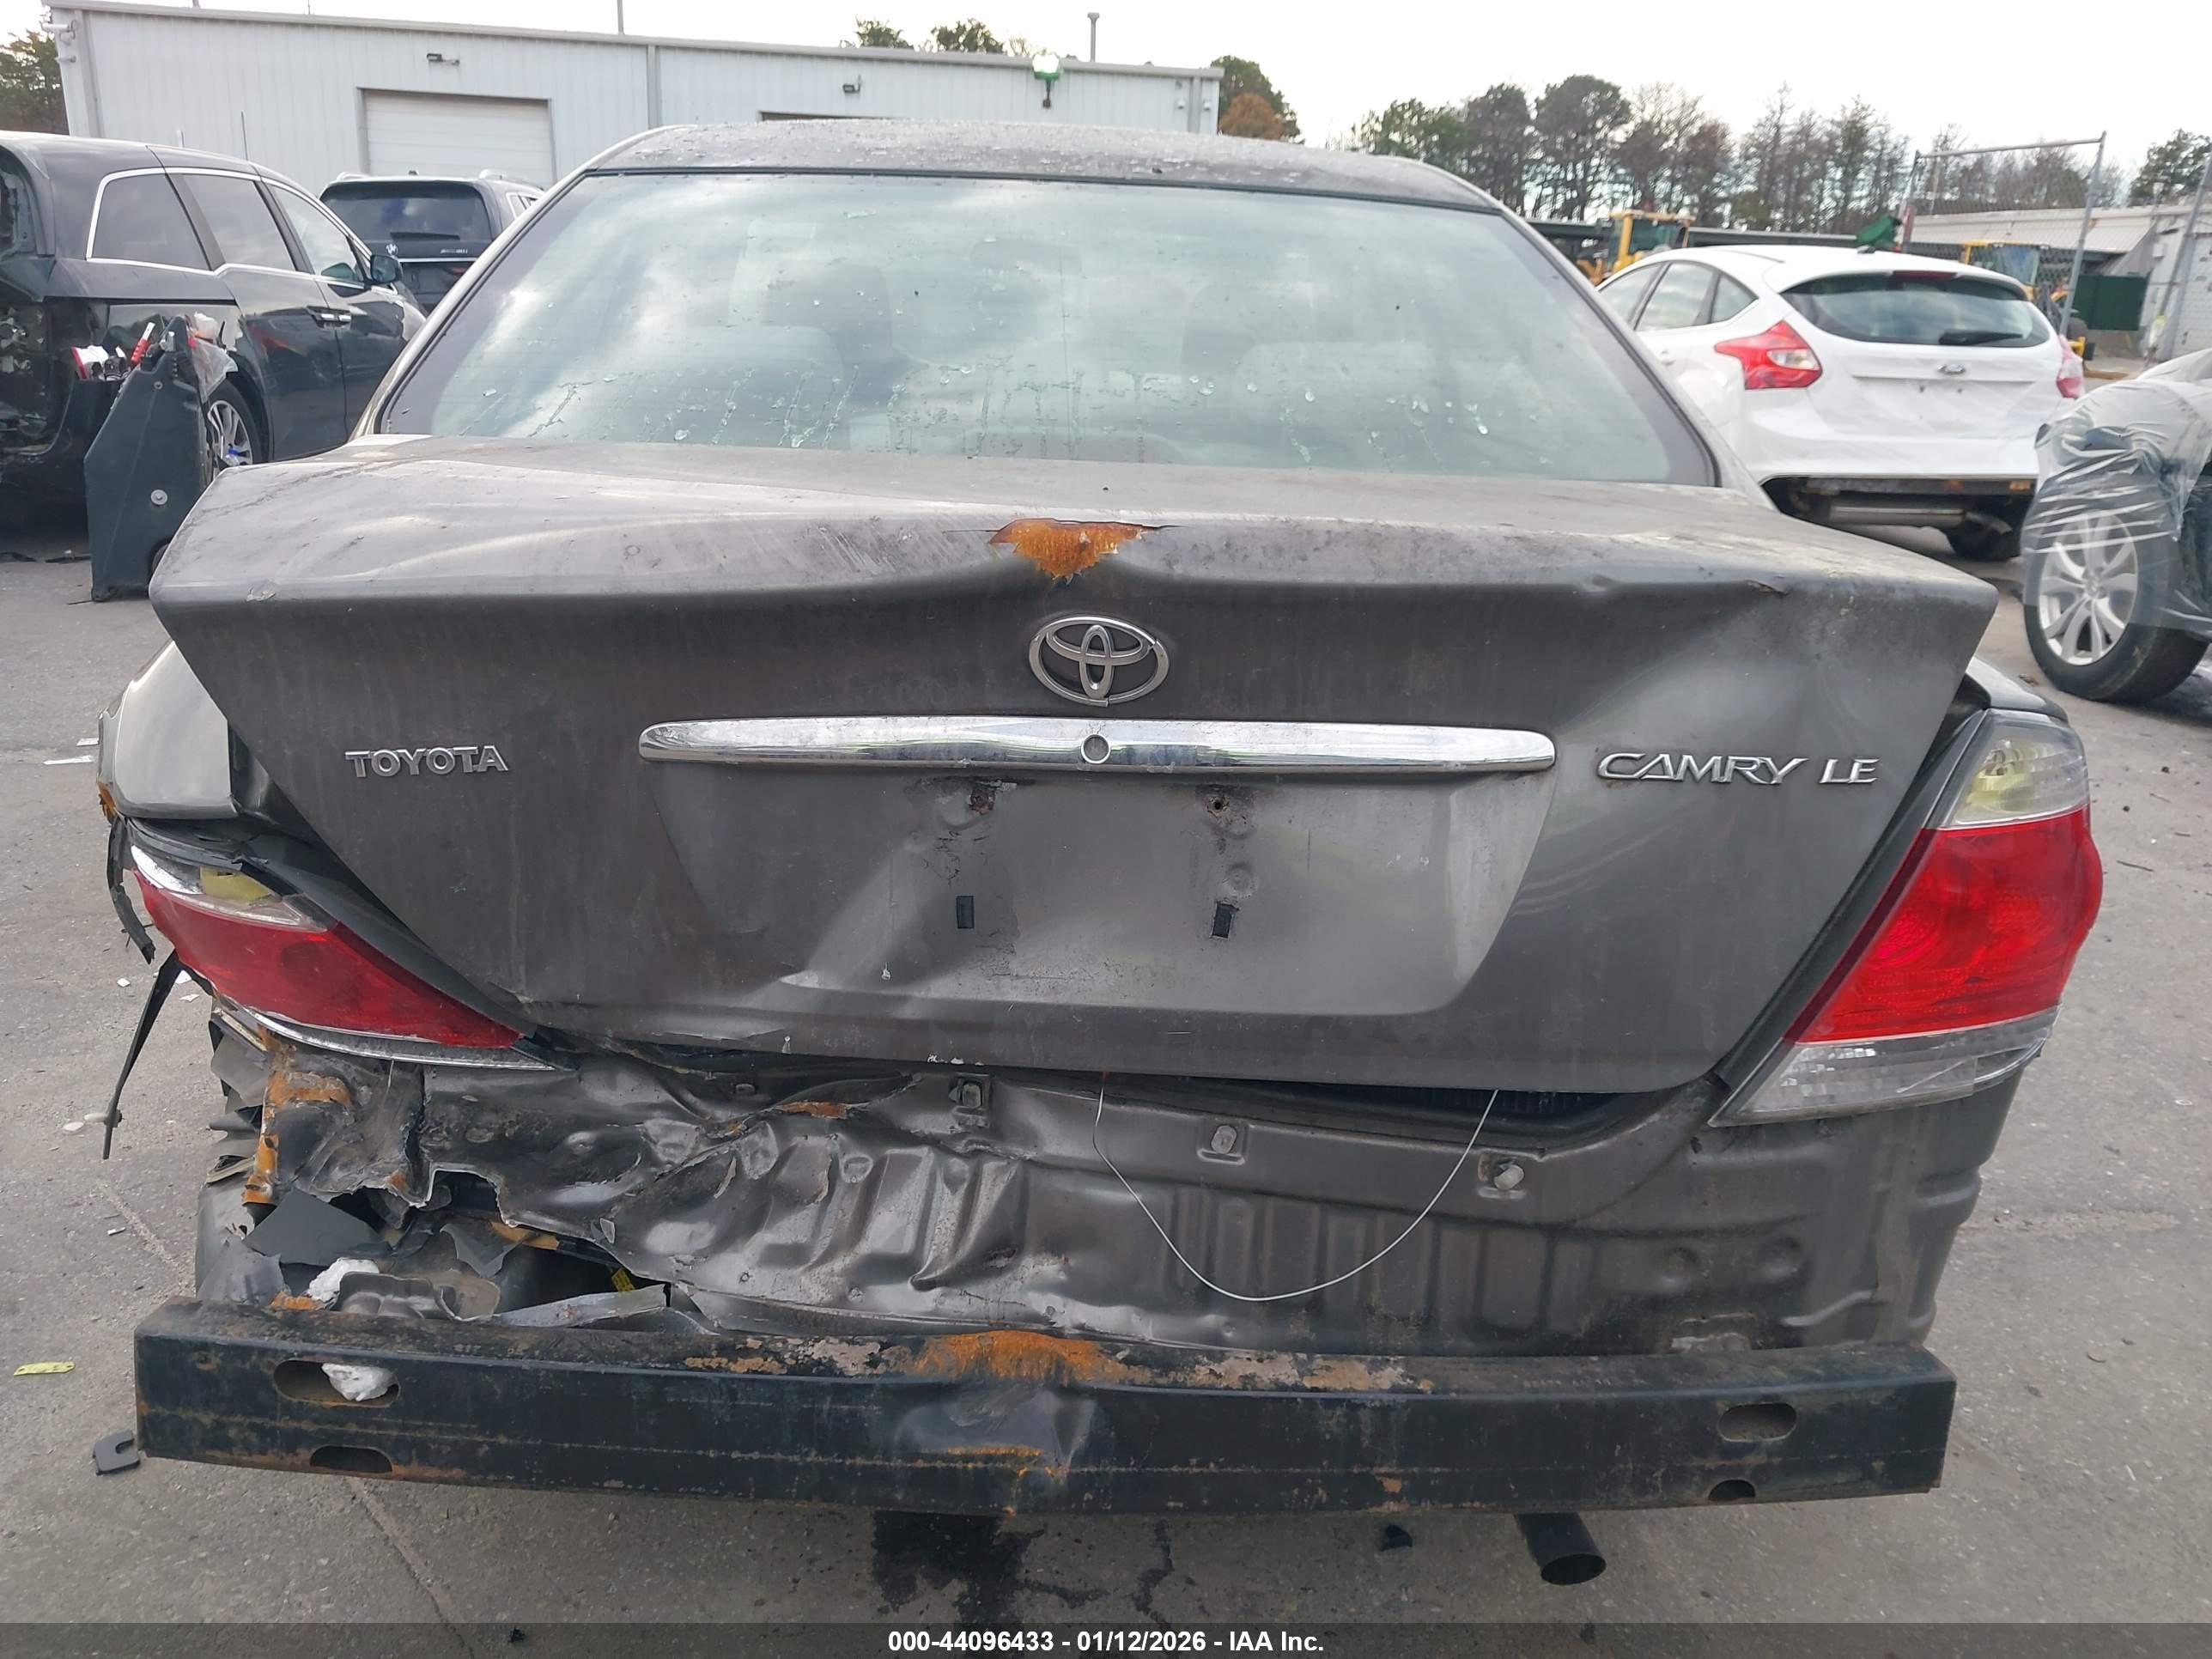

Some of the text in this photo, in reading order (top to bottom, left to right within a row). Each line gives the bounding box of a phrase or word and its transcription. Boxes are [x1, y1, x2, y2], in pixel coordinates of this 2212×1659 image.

[344, 744, 509, 778] TOYOTA
[1595, 752, 1880, 785] CAMRY LE
